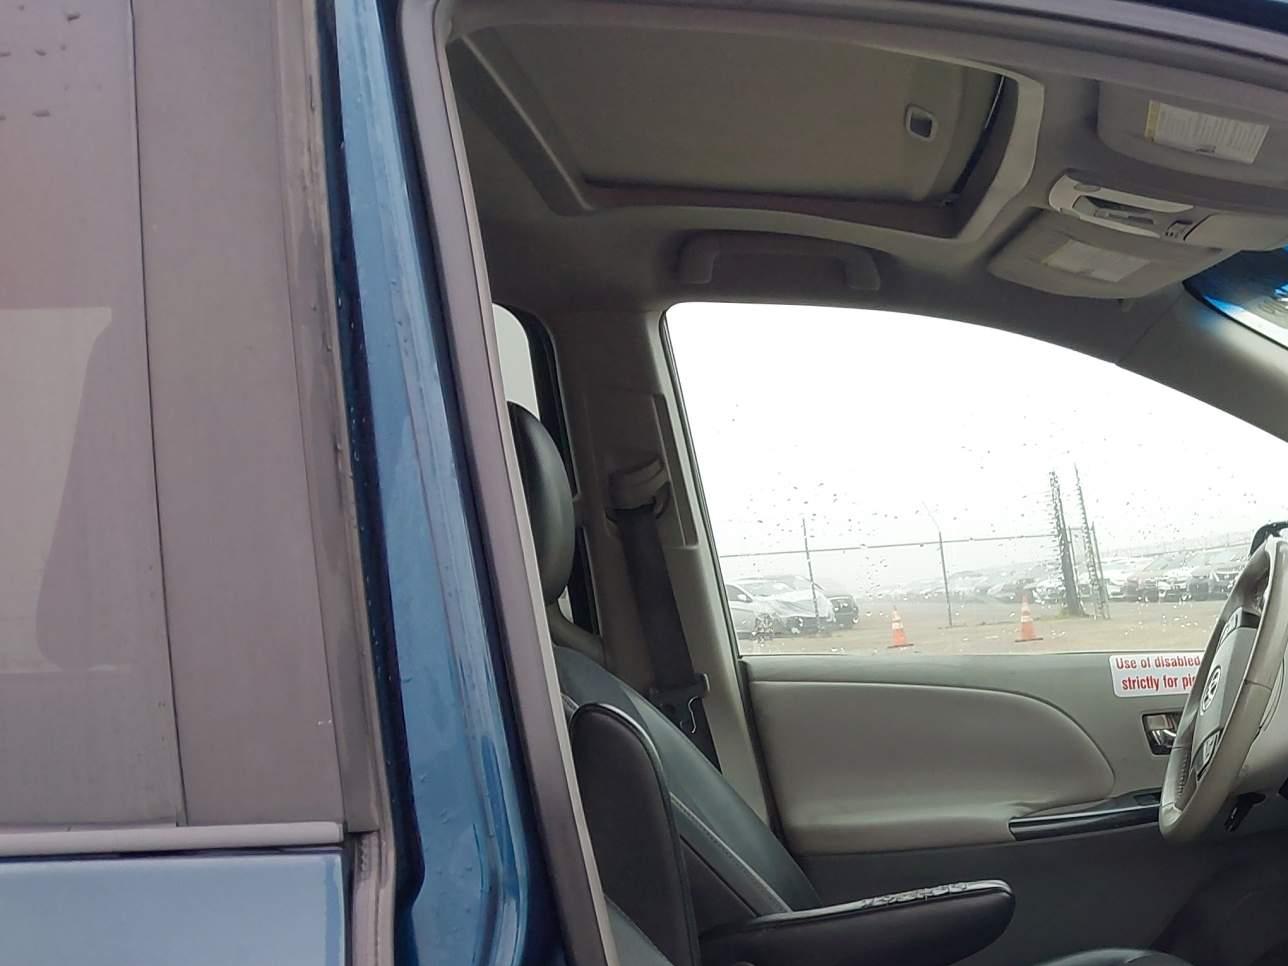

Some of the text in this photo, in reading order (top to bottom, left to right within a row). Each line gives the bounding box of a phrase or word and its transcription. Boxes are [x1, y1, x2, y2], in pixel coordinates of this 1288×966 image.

[1115, 655, 1200, 670] Use of disabled
[1121, 675, 1160, 691] strictly
[1163, 674, 1178, 689] for
